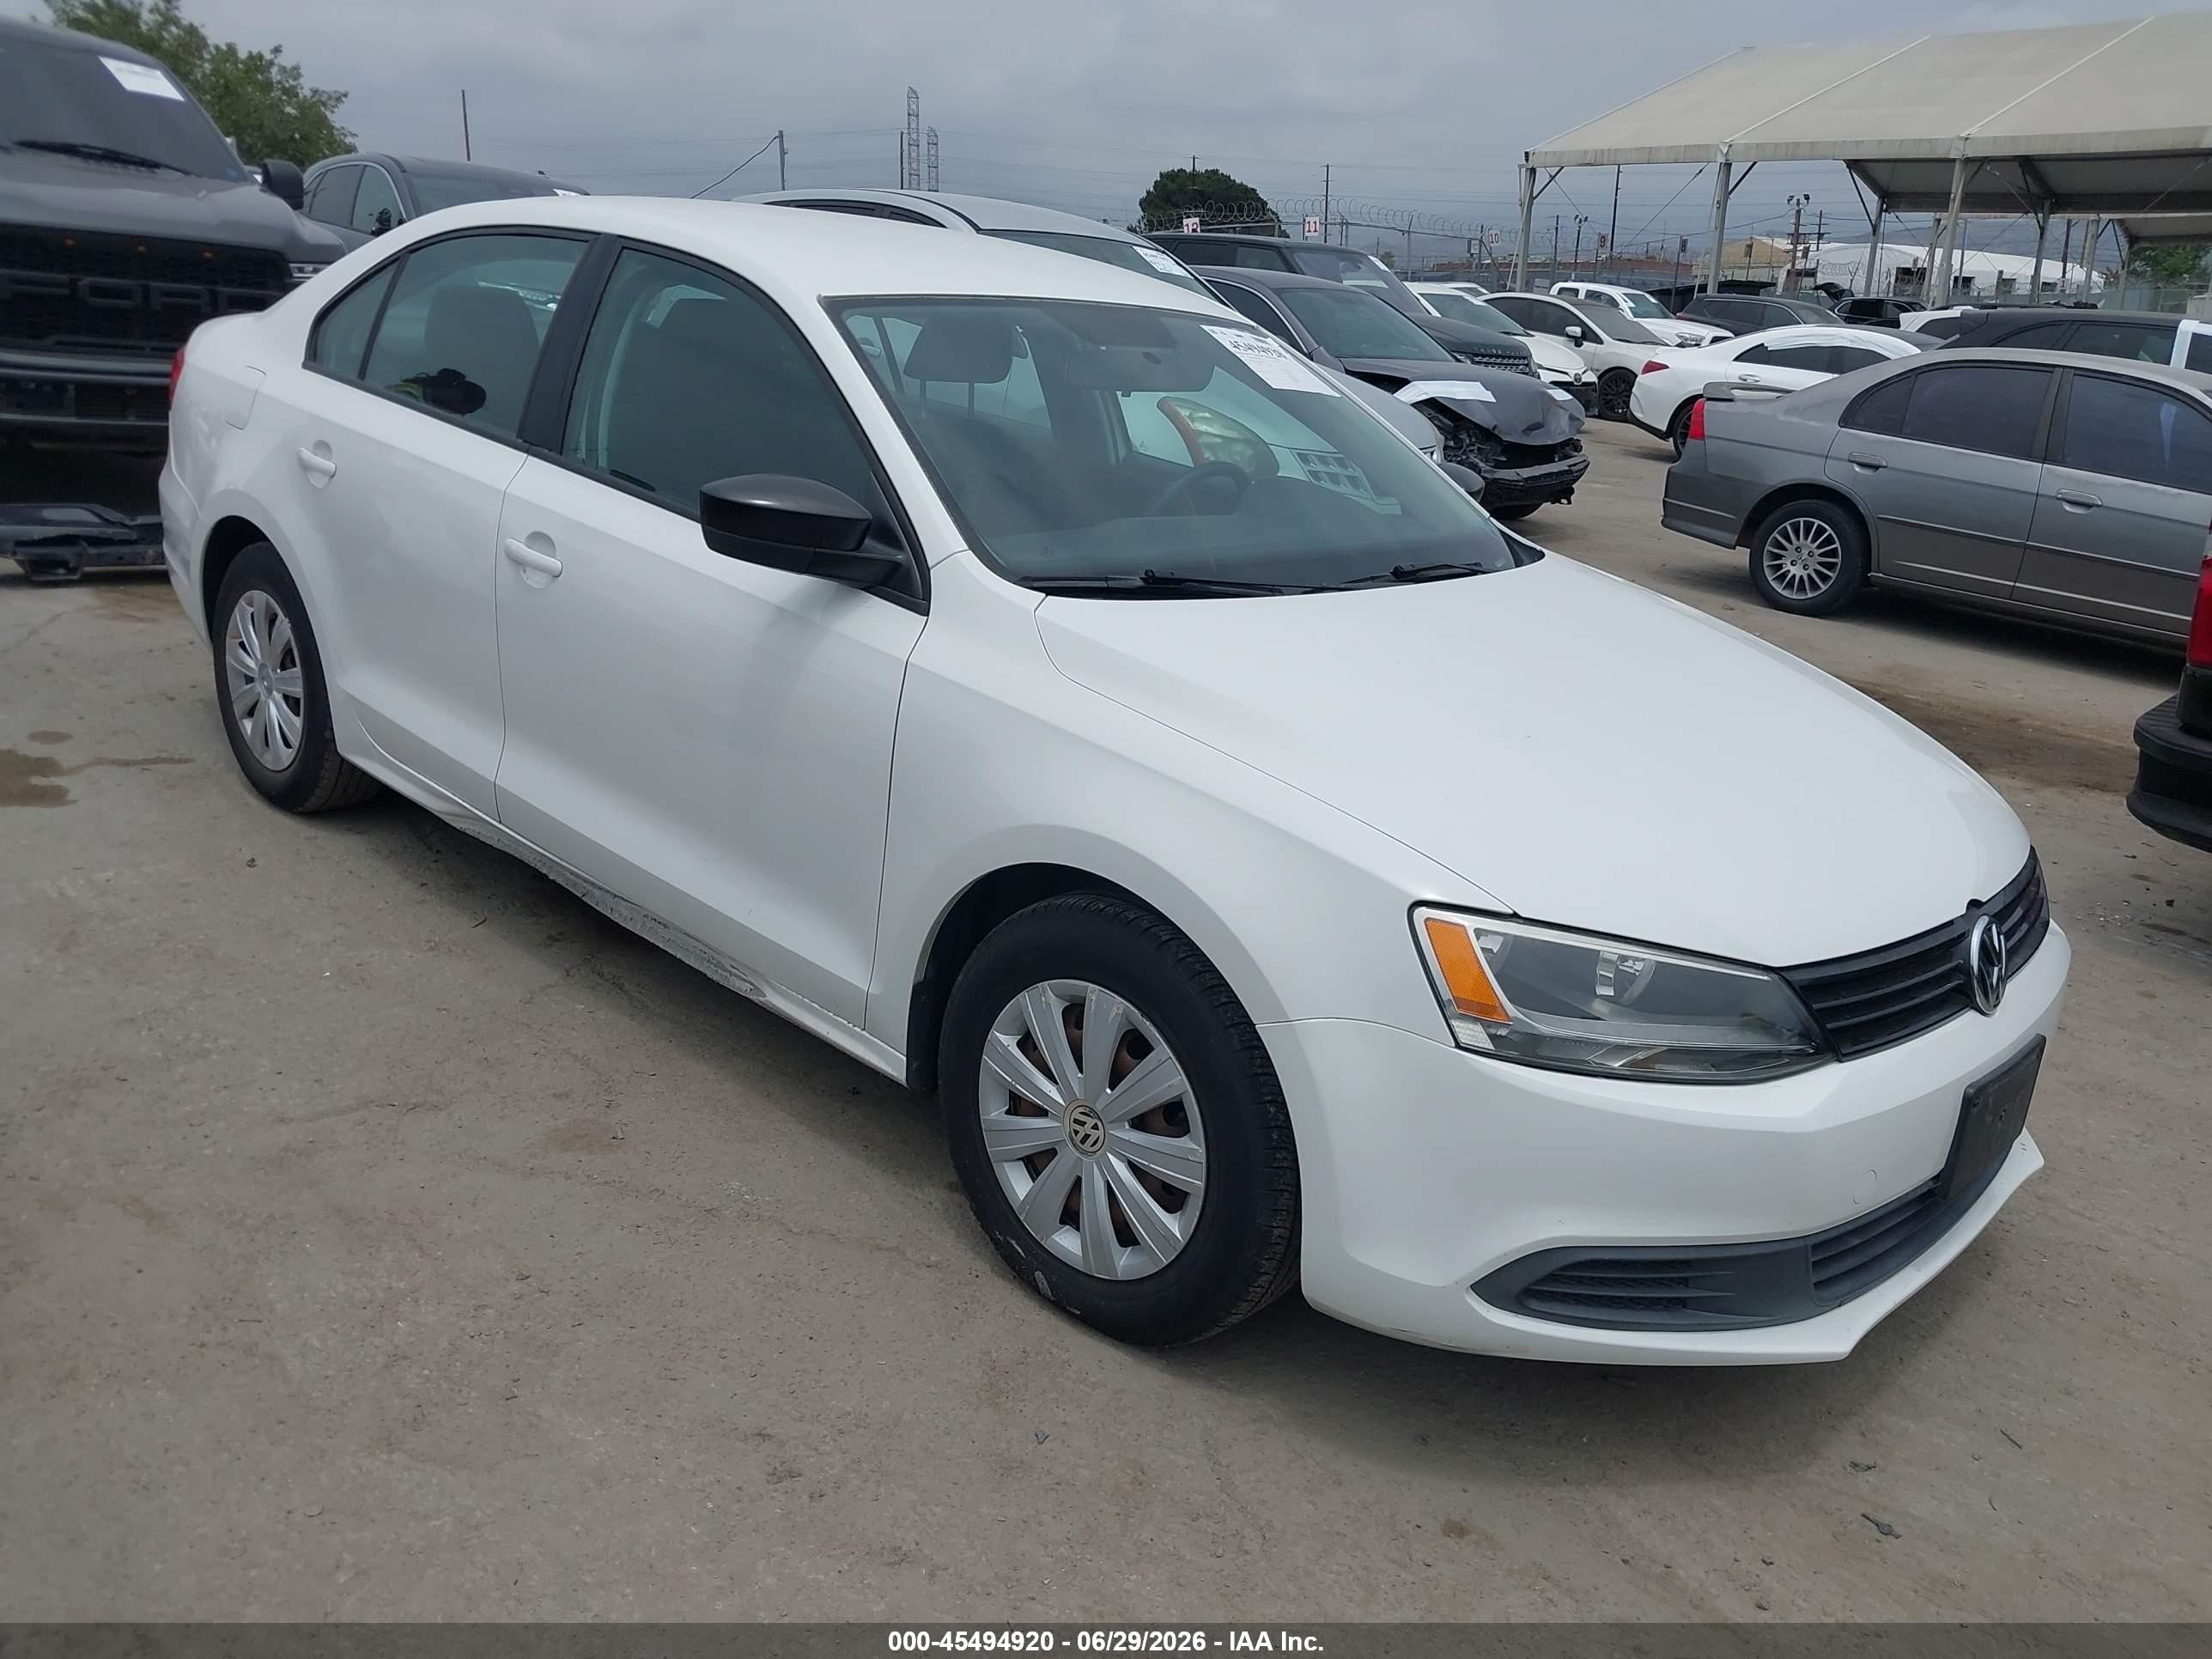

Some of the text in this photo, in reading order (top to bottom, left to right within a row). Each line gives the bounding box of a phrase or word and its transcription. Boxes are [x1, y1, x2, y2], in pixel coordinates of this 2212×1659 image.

[1306, 221, 1319, 234] 11
[1489, 233, 1499, 244] 10
[1600, 235, 1606, 248] 9
